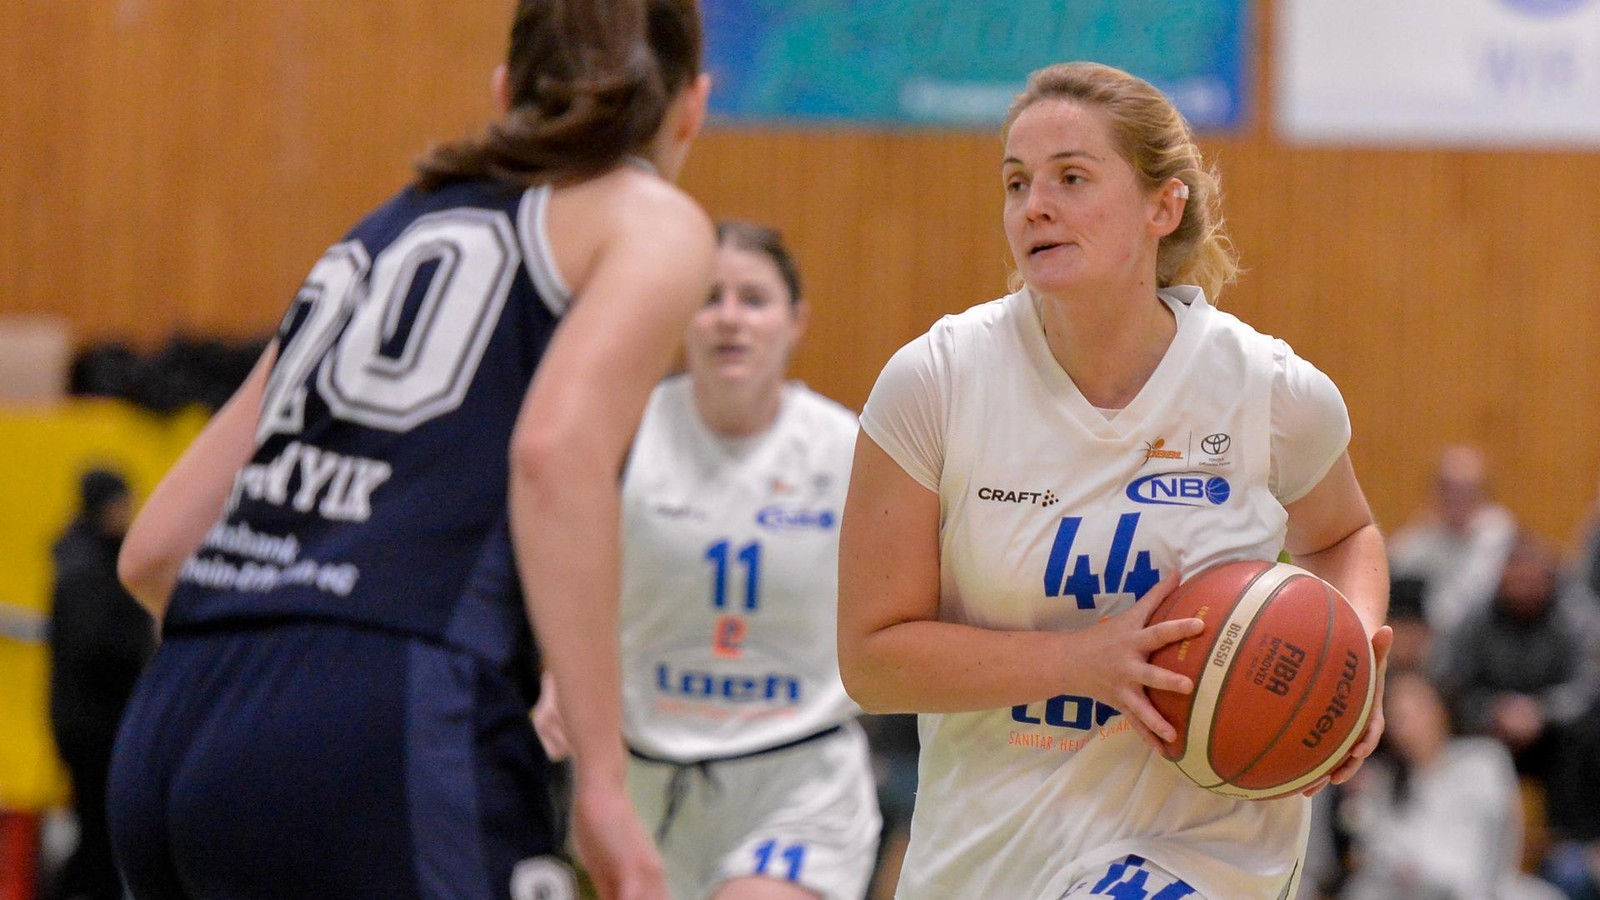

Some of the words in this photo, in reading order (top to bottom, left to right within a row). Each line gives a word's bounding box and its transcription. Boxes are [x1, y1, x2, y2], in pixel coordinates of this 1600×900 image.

[978, 487, 1041, 504] CRAFT
[706, 538, 762, 609] 11
[1044, 512, 1160, 609] 44
[1265, 642, 1306, 697] FIBA
[1302, 650, 1359, 749] molten
[752, 839, 808, 883] 11
